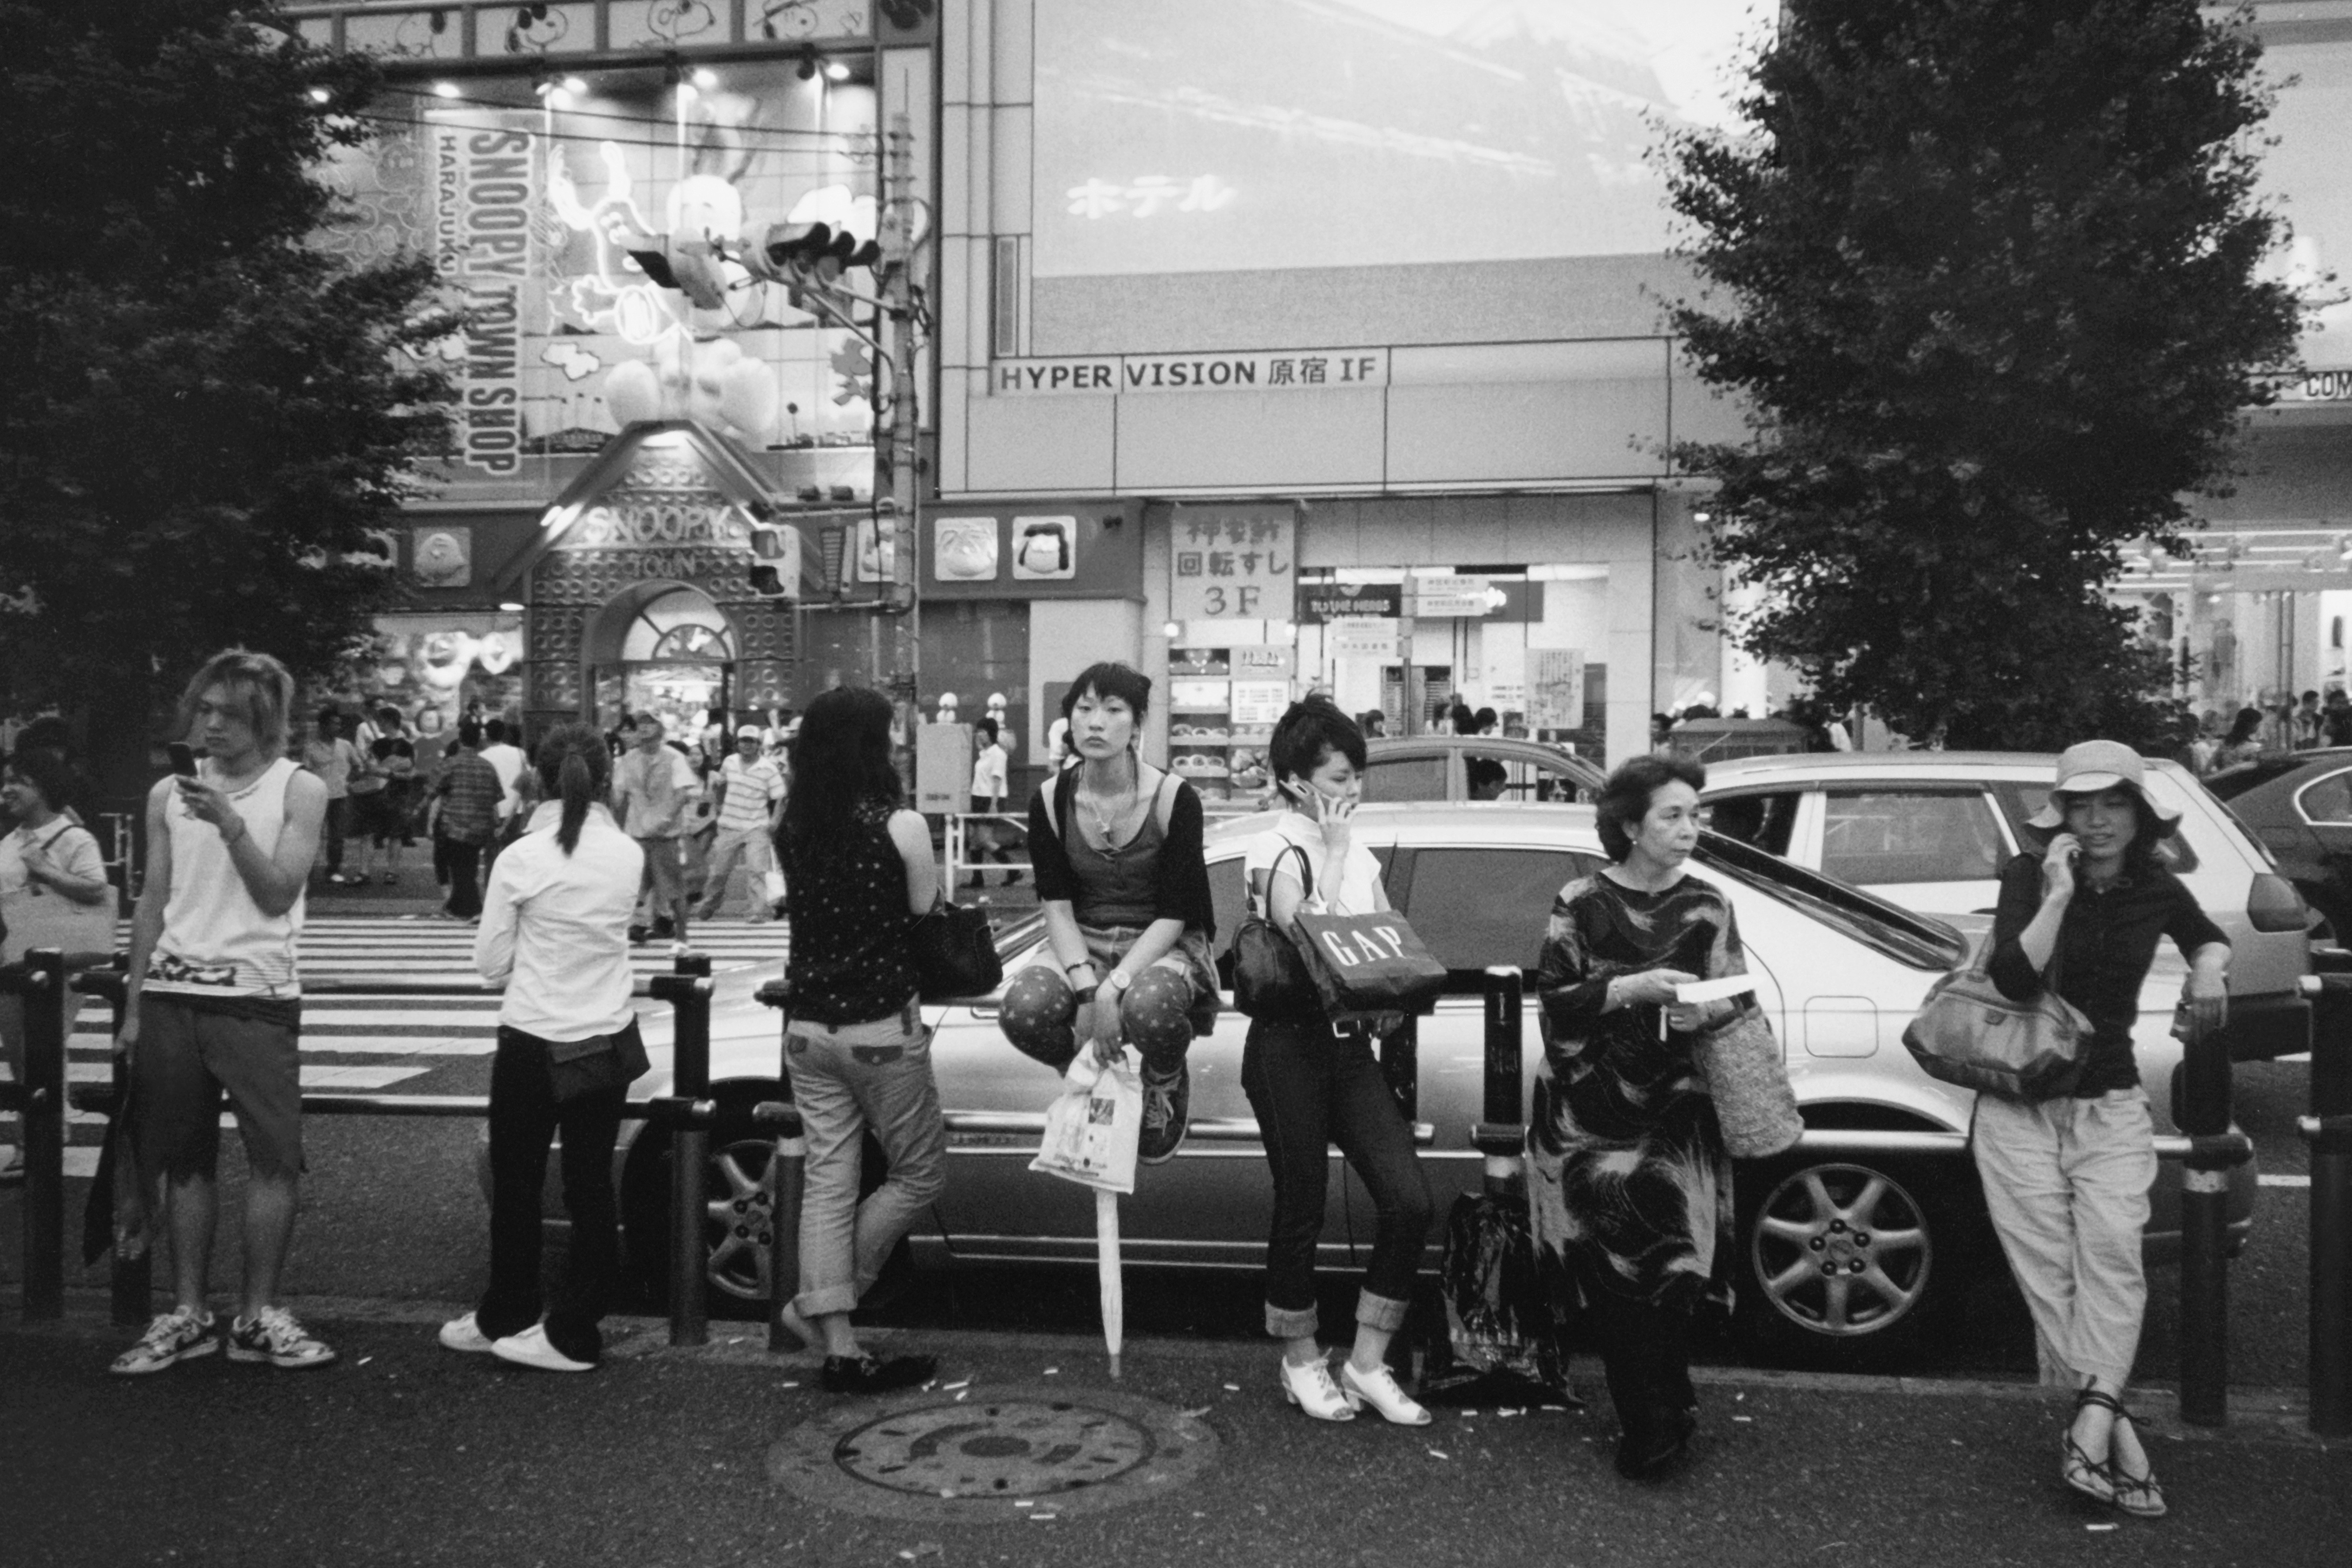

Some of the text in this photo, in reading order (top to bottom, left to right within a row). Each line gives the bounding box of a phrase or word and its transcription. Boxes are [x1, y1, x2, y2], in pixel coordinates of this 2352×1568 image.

[439, 135, 456, 272] HARAJUKU
[1066, 173, 1239, 220] ホテル
[467, 131, 530, 471] SNOOPY TOWN SHOP
[1001, 356, 1376, 389] HYPER VISION 原宿 IF
[585, 505, 732, 542] SNOOPY
[1177, 551, 1289, 576] 回転すし
[1321, 926, 1406, 966] GAP
